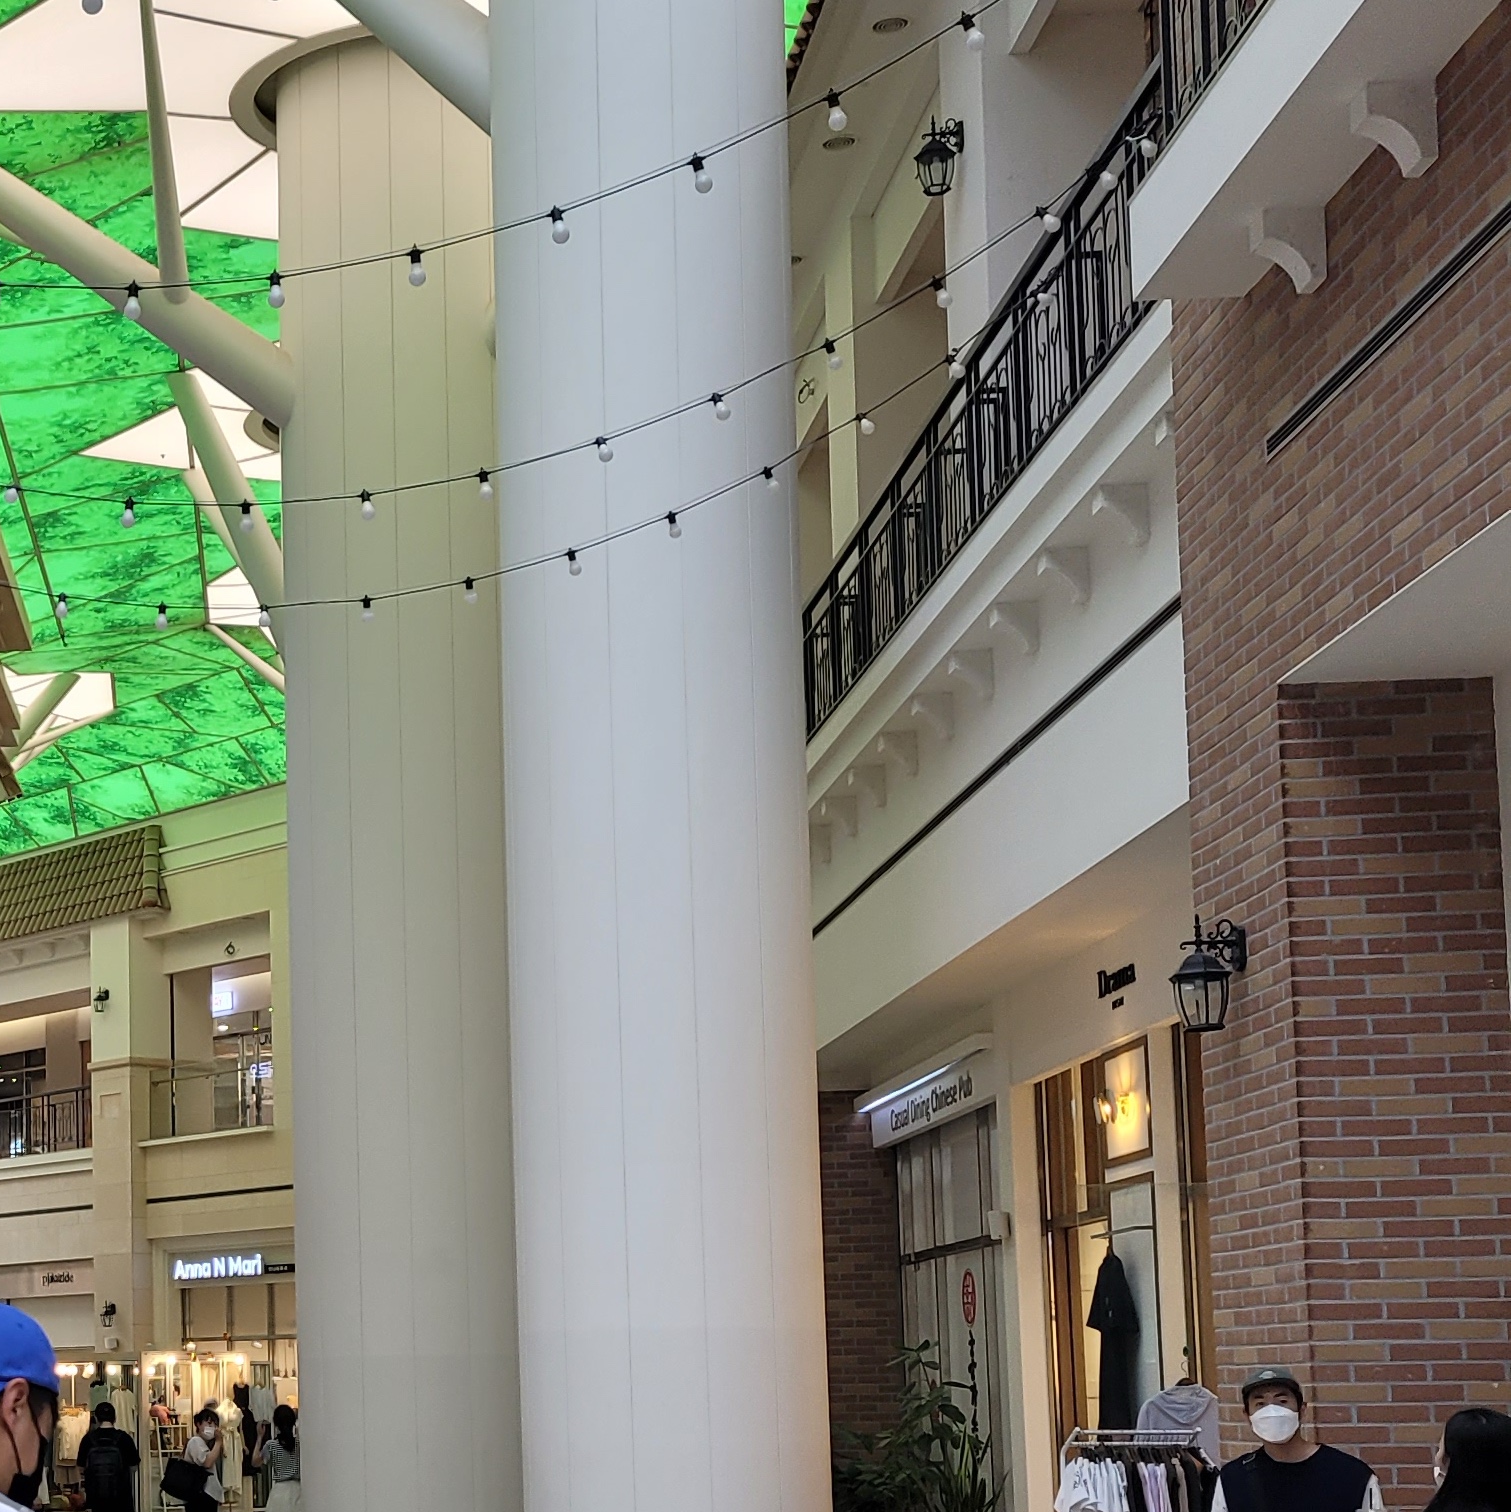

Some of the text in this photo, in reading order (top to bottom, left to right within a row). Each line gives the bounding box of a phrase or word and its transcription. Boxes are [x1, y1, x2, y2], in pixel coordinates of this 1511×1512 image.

[890, 1069, 973, 1132] Casual Dining Chinese Pub
[174, 1253, 264, 1281] Anna N Mari
